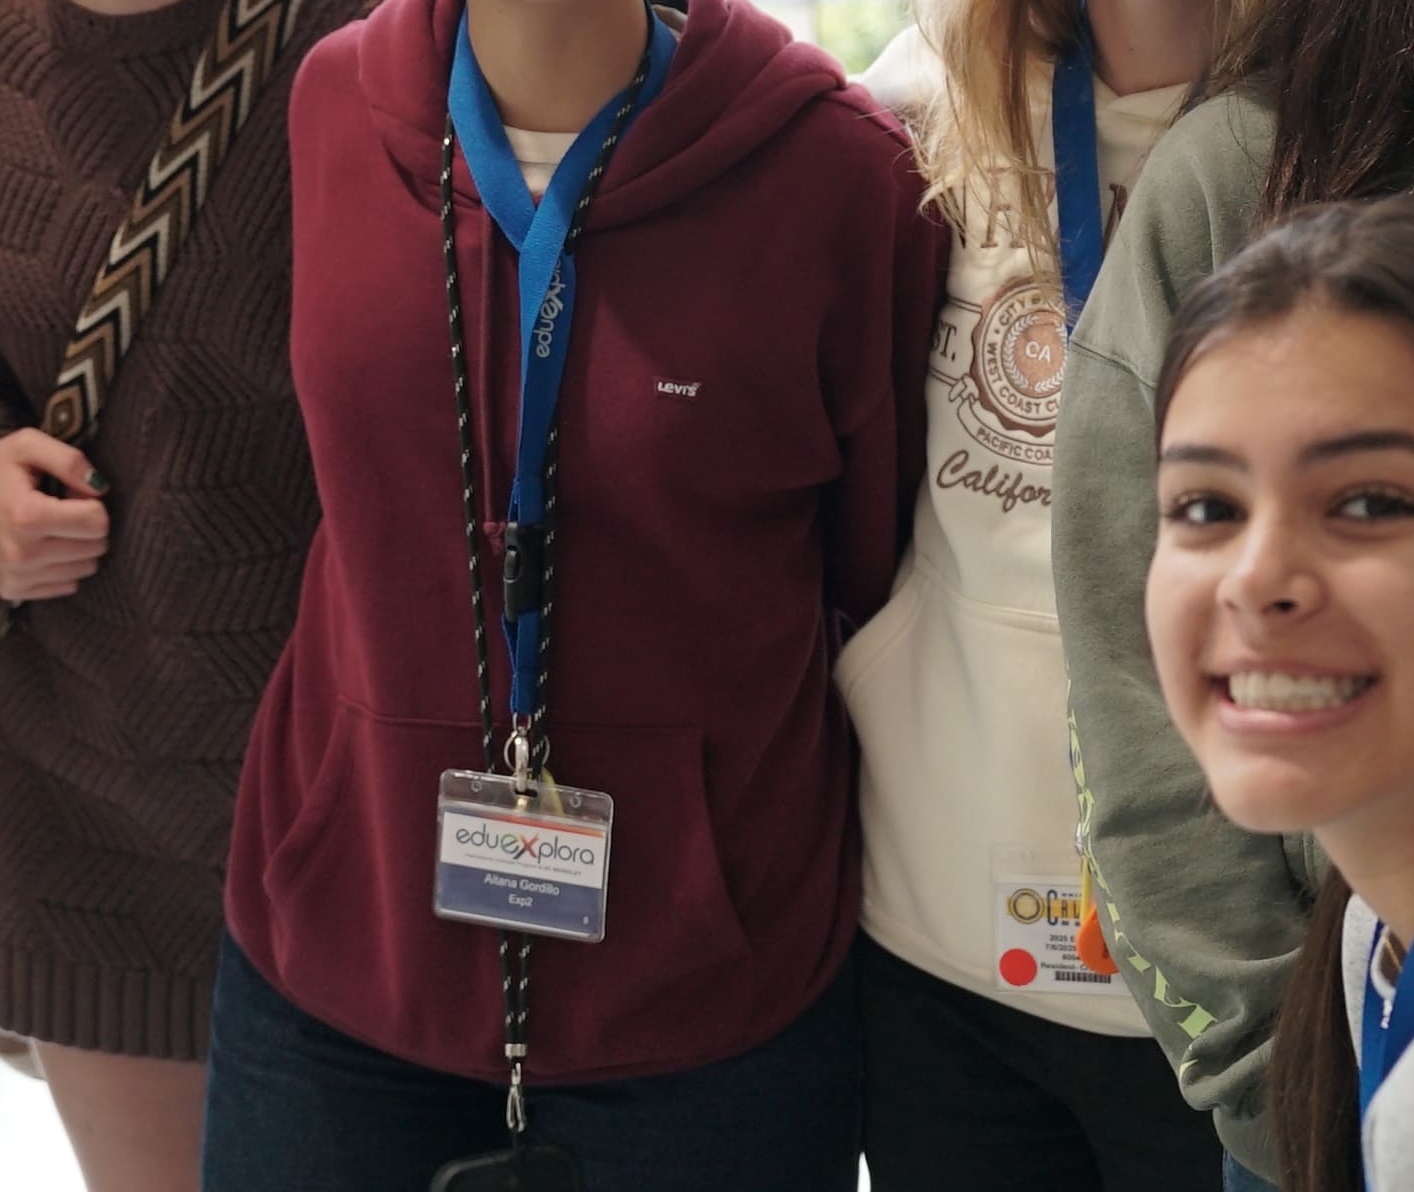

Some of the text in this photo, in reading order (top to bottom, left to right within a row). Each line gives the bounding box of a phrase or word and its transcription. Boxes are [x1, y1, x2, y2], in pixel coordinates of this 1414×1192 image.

[987, 341, 1042, 415] WEST COAST
[975, 426, 1053, 461] PACIFIC COA
[936, 449, 1053, 513] Califor
